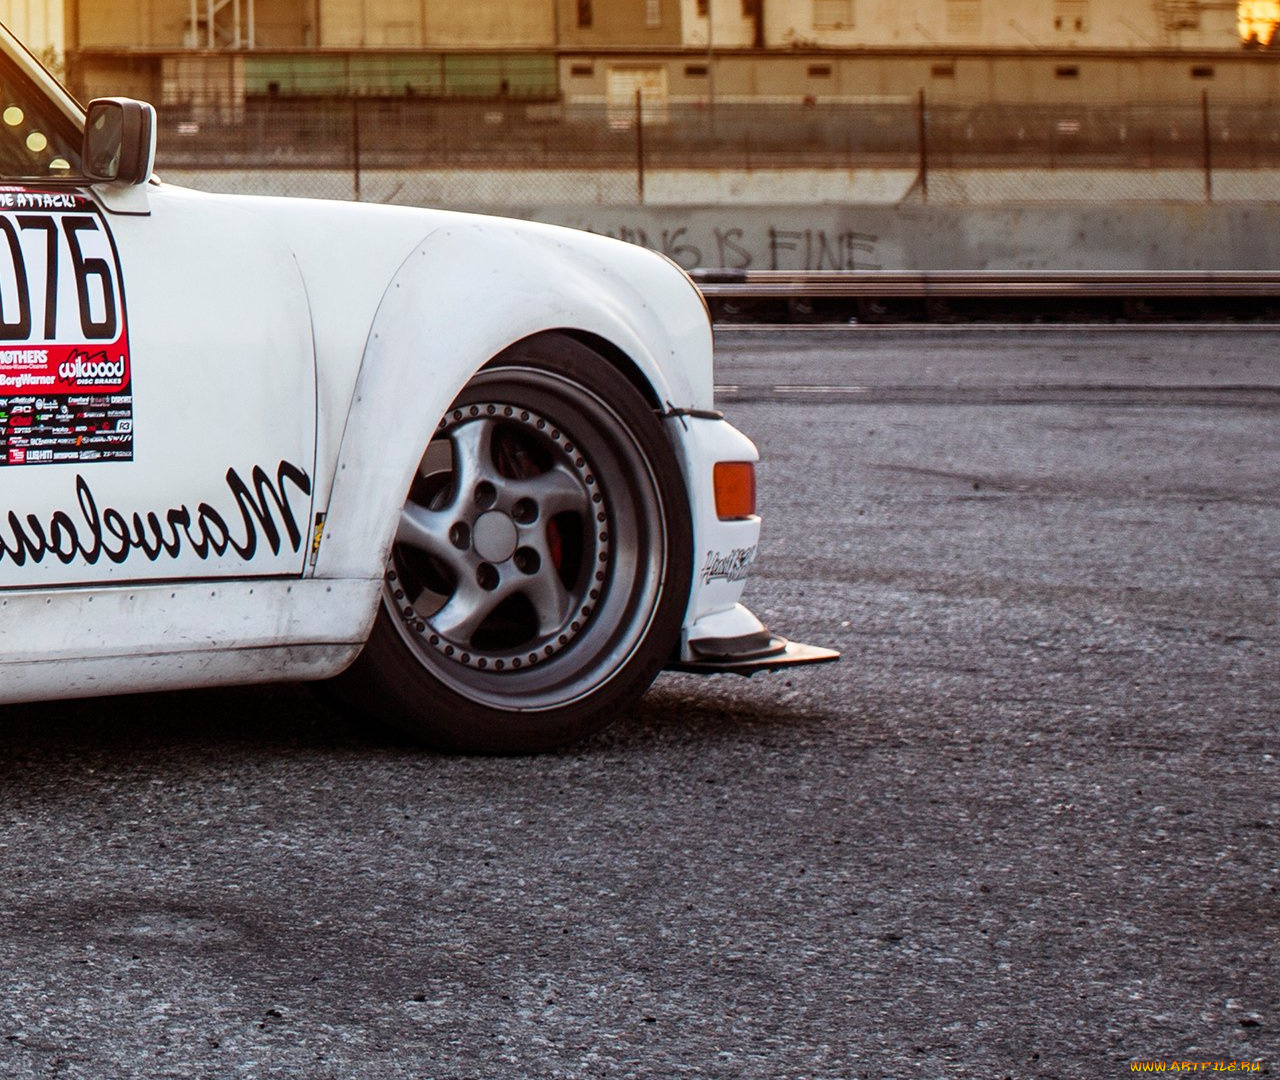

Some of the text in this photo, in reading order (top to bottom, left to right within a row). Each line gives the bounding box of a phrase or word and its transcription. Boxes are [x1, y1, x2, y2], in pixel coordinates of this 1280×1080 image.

[17, 193, 76, 208] ATTACK!
[769, 226, 882, 271] FINE
[0, 374, 56, 388] BorgWarner
